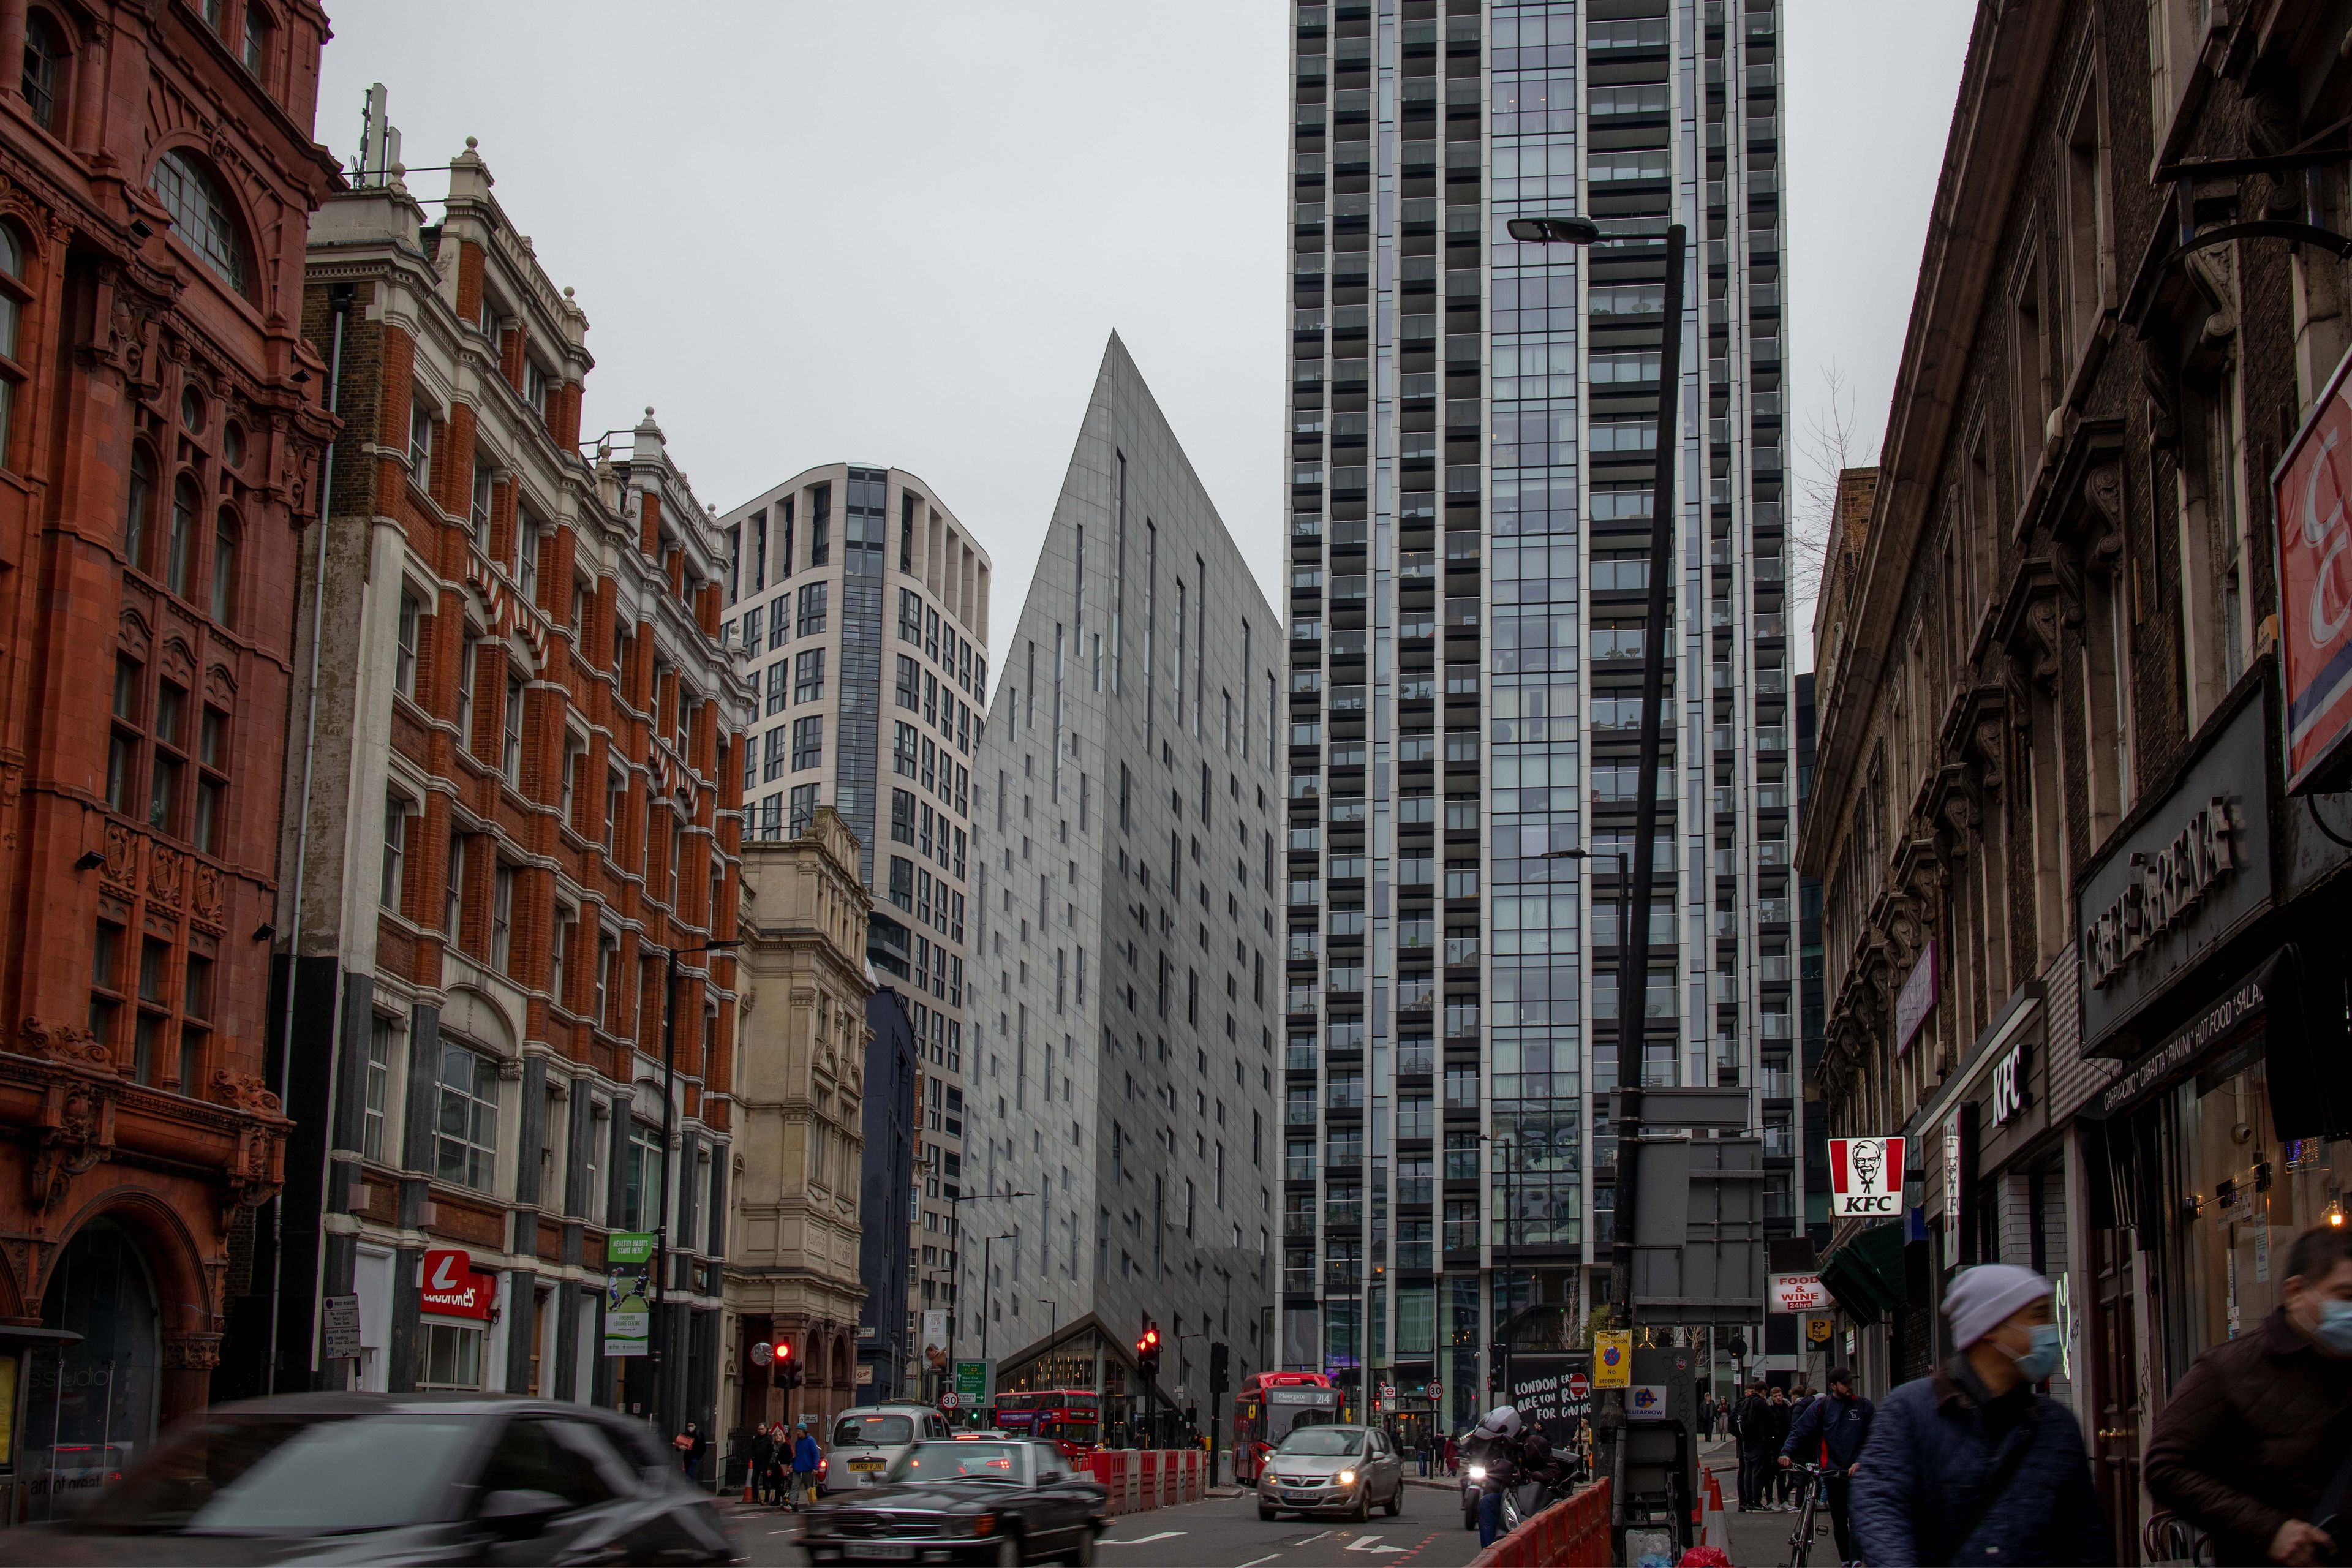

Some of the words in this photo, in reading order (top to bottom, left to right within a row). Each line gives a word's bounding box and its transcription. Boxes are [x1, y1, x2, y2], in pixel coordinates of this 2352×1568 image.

[2141, 796, 2235, 946] ARENA
[2168, 1032, 2191, 1066] PANINI
[2195, 1016, 2209, 1048] HOT
[2209, 1000, 2231, 1036] FOOD
[1992, 1044, 2021, 1128] KFC
[1844, 1196, 1892, 1213] KFC
[1779, 1276, 1819, 1285] FOOD
[1781, 1292, 1819, 1301] WINE
[1515, 1376, 1558, 1396] LONDON
[1316, 1393, 1330, 1404] 214
[1517, 1395, 1539, 1414] ARE
[1539, 1393, 1556, 1404] YOU
[1536, 1407, 1556, 1420] FOR
[31, 1476, 48, 1495] art
[53, 1476, 66, 1494] of
